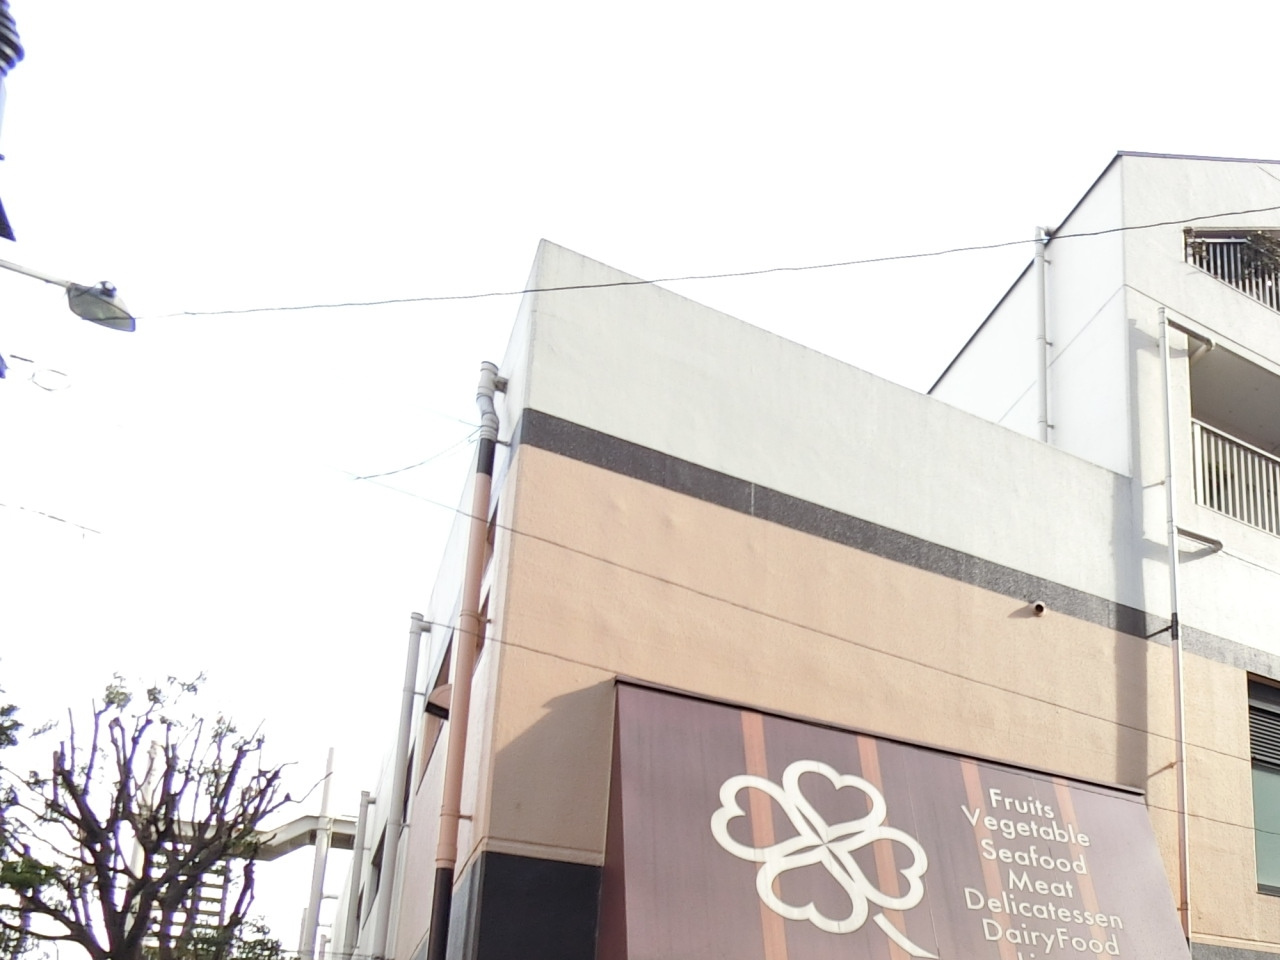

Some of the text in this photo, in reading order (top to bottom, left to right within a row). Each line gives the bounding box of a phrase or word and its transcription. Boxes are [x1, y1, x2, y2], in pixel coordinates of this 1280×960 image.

[989, 788, 1055, 819] Fruits
[961, 804, 1090, 847] Vegetable
[981, 838, 1087, 875] Seafood
[1008, 869, 1073, 898] Meat
[964, 887, 1124, 930] Delicatessen
[982, 918, 1121, 957] DairyFood
